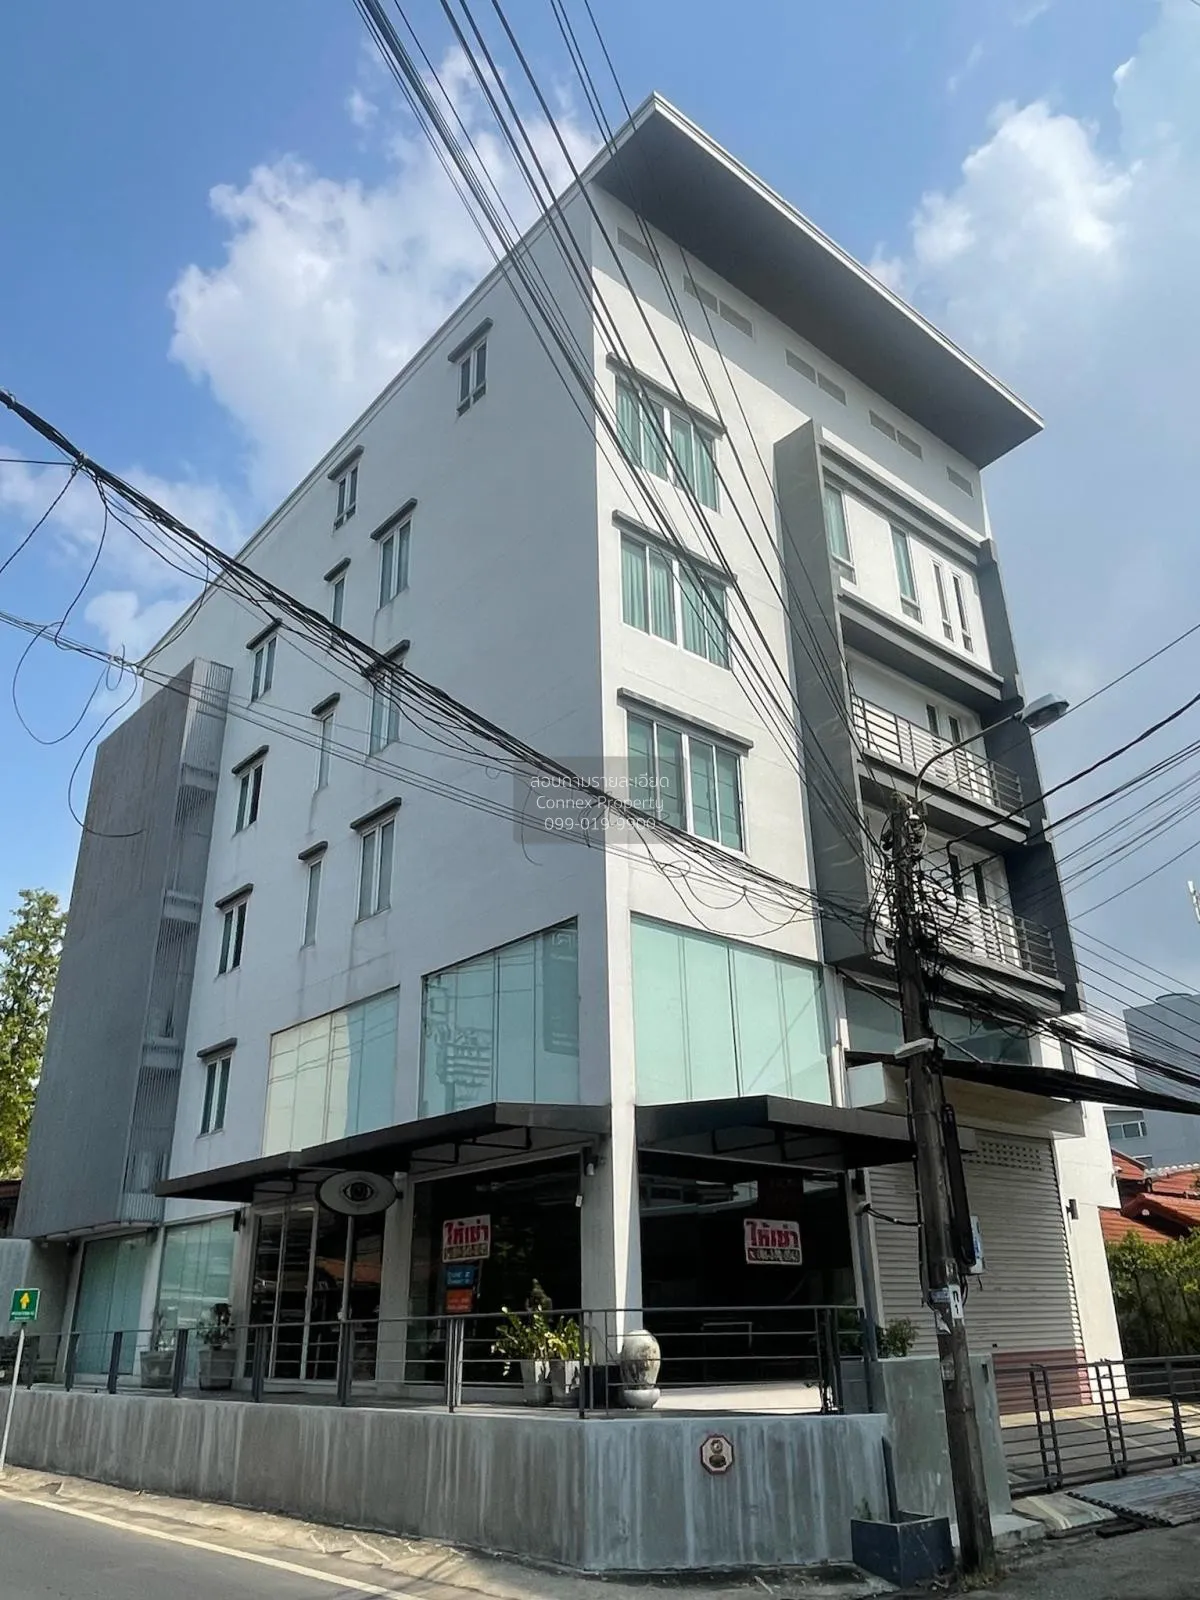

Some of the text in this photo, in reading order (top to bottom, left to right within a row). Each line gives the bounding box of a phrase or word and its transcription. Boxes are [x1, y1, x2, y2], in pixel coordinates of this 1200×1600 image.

[444, 1218, 489, 1245] ให้เช่า
[746, 1220, 799, 1248] ให้เช่า
